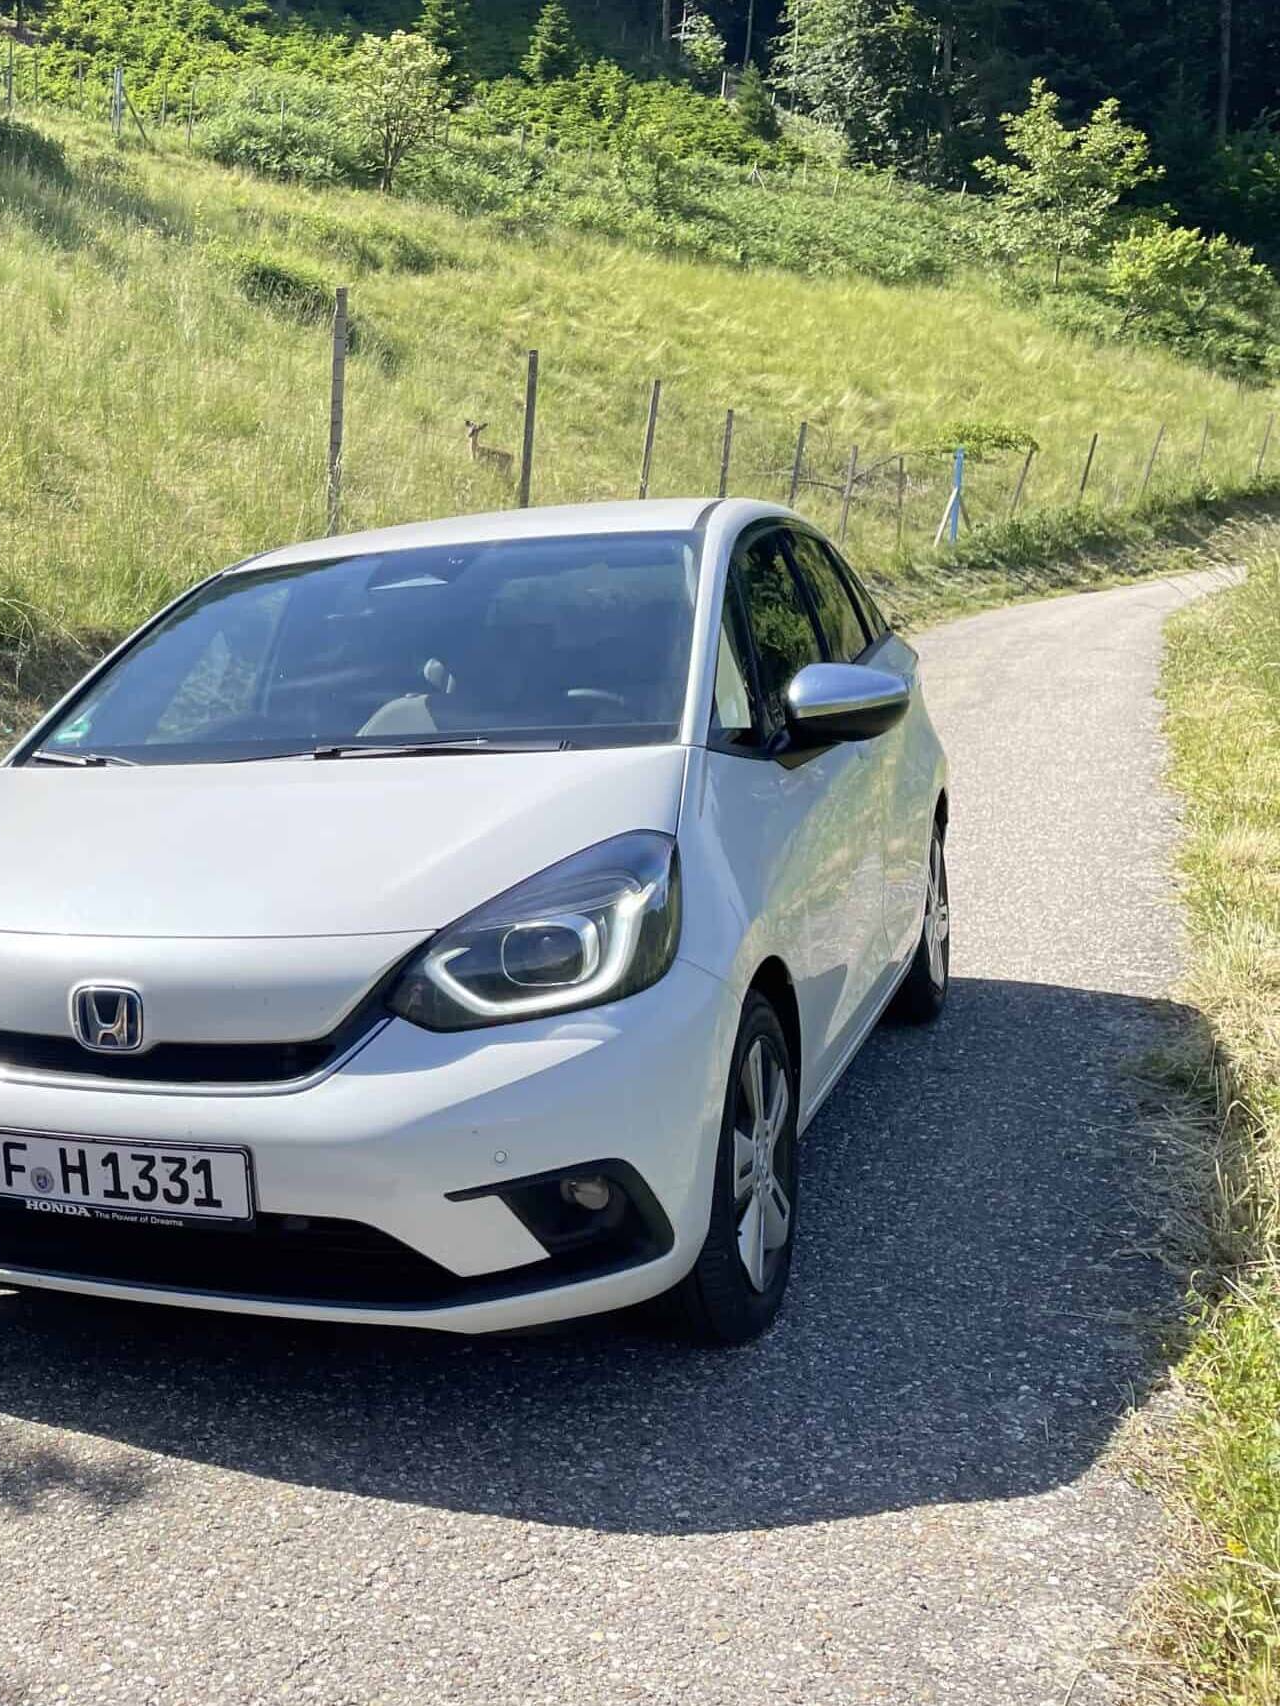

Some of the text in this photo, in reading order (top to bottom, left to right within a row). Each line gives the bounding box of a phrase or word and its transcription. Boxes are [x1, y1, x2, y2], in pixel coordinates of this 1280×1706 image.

[25, 1199, 91, 1218] HONDA
[111, 1211, 138, 1223] Power
[139, 1214, 149, 1224] of
[150, 1215, 184, 1228] Dreams
